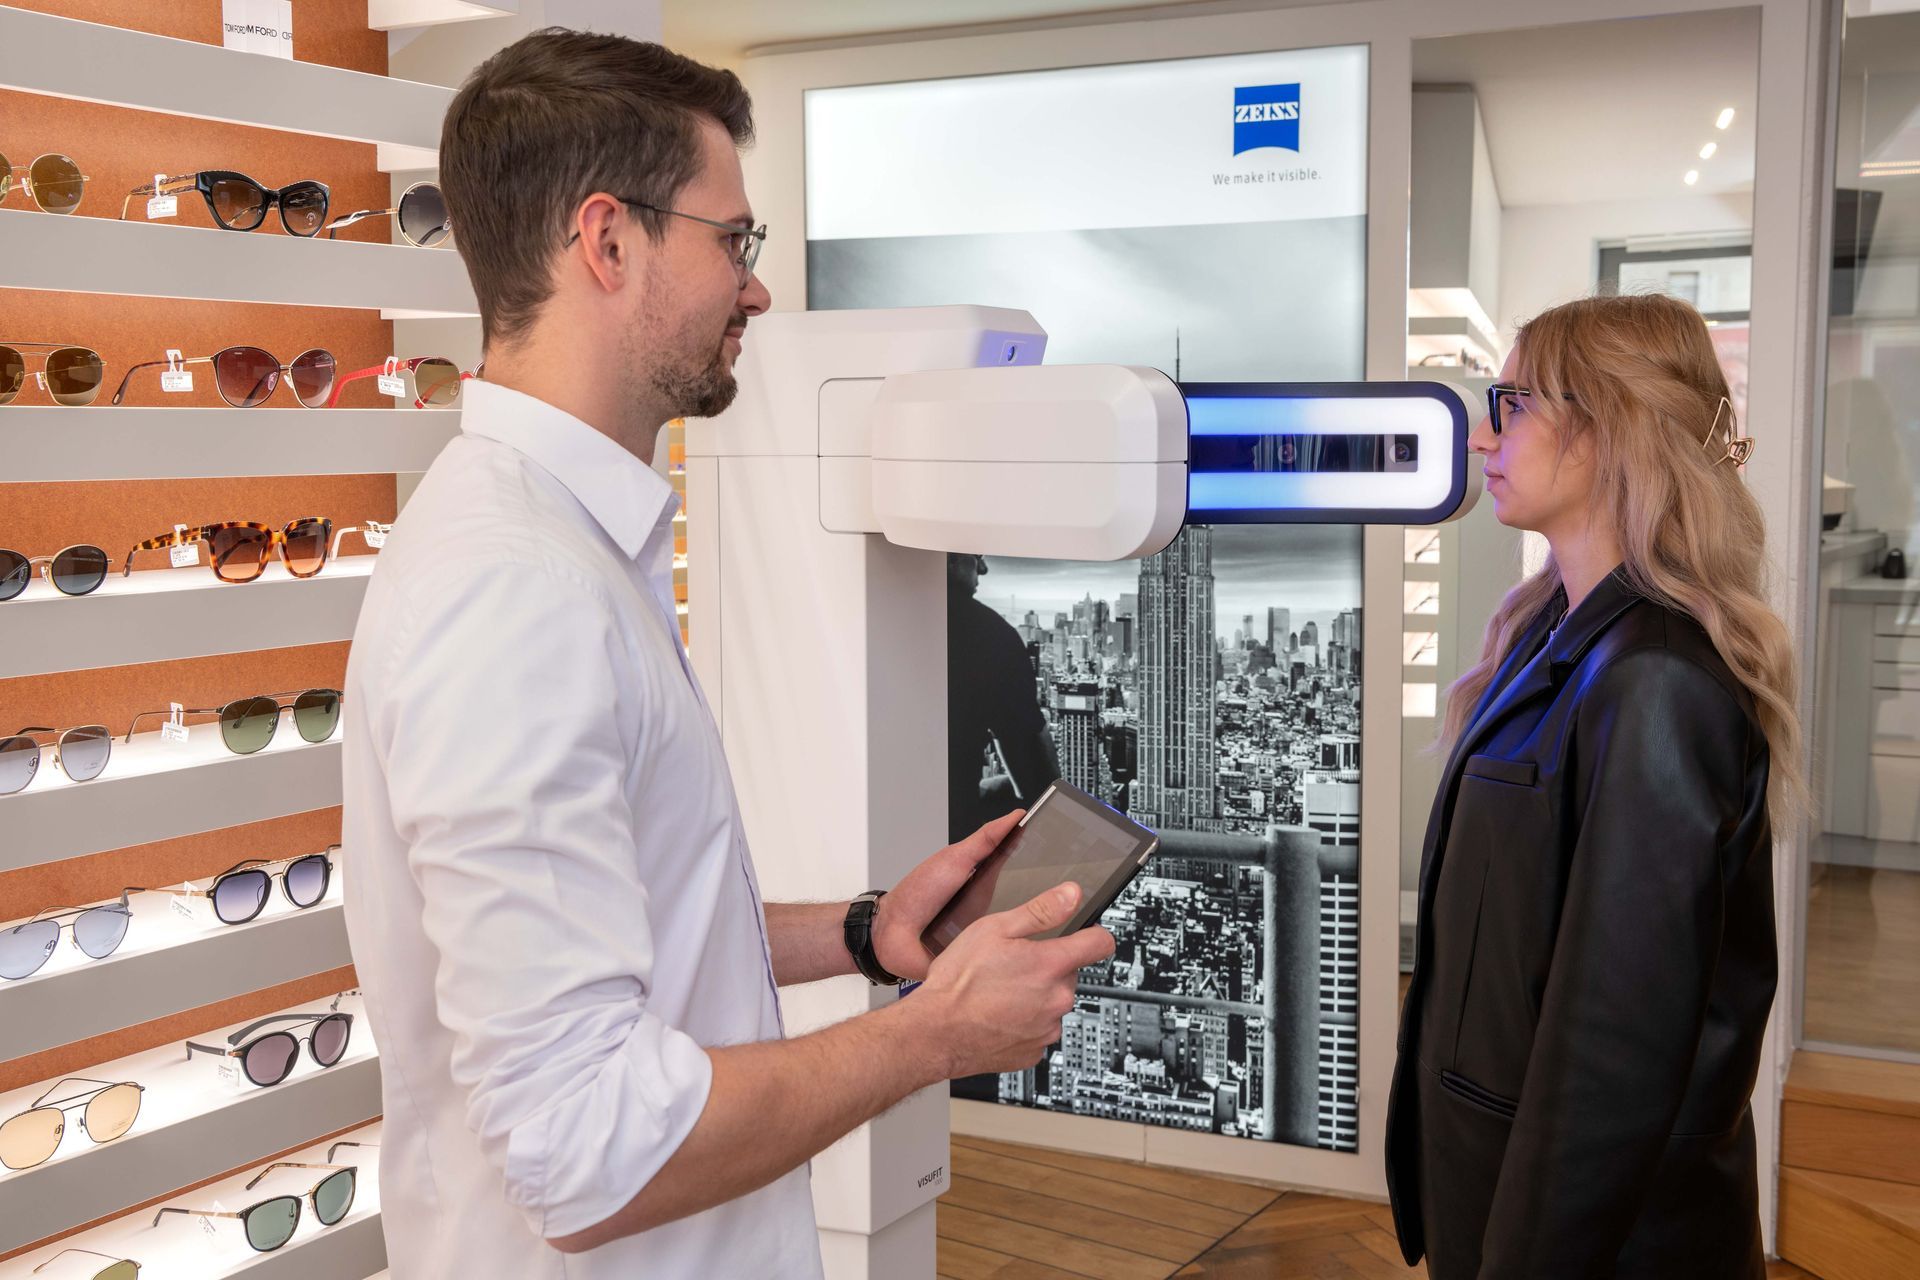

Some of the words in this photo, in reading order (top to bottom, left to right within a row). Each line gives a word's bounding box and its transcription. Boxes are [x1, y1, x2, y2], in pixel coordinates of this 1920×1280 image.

[255, 26, 277, 37] FORD
[1235, 101, 1298, 123] ZEISS
[1212, 173, 1230, 185] We
[1233, 171, 1264, 184] make
[1267, 170, 1276, 183] it
[1278, 168, 1322, 182] visible.
[917, 1166, 943, 1188] VISUFIT
